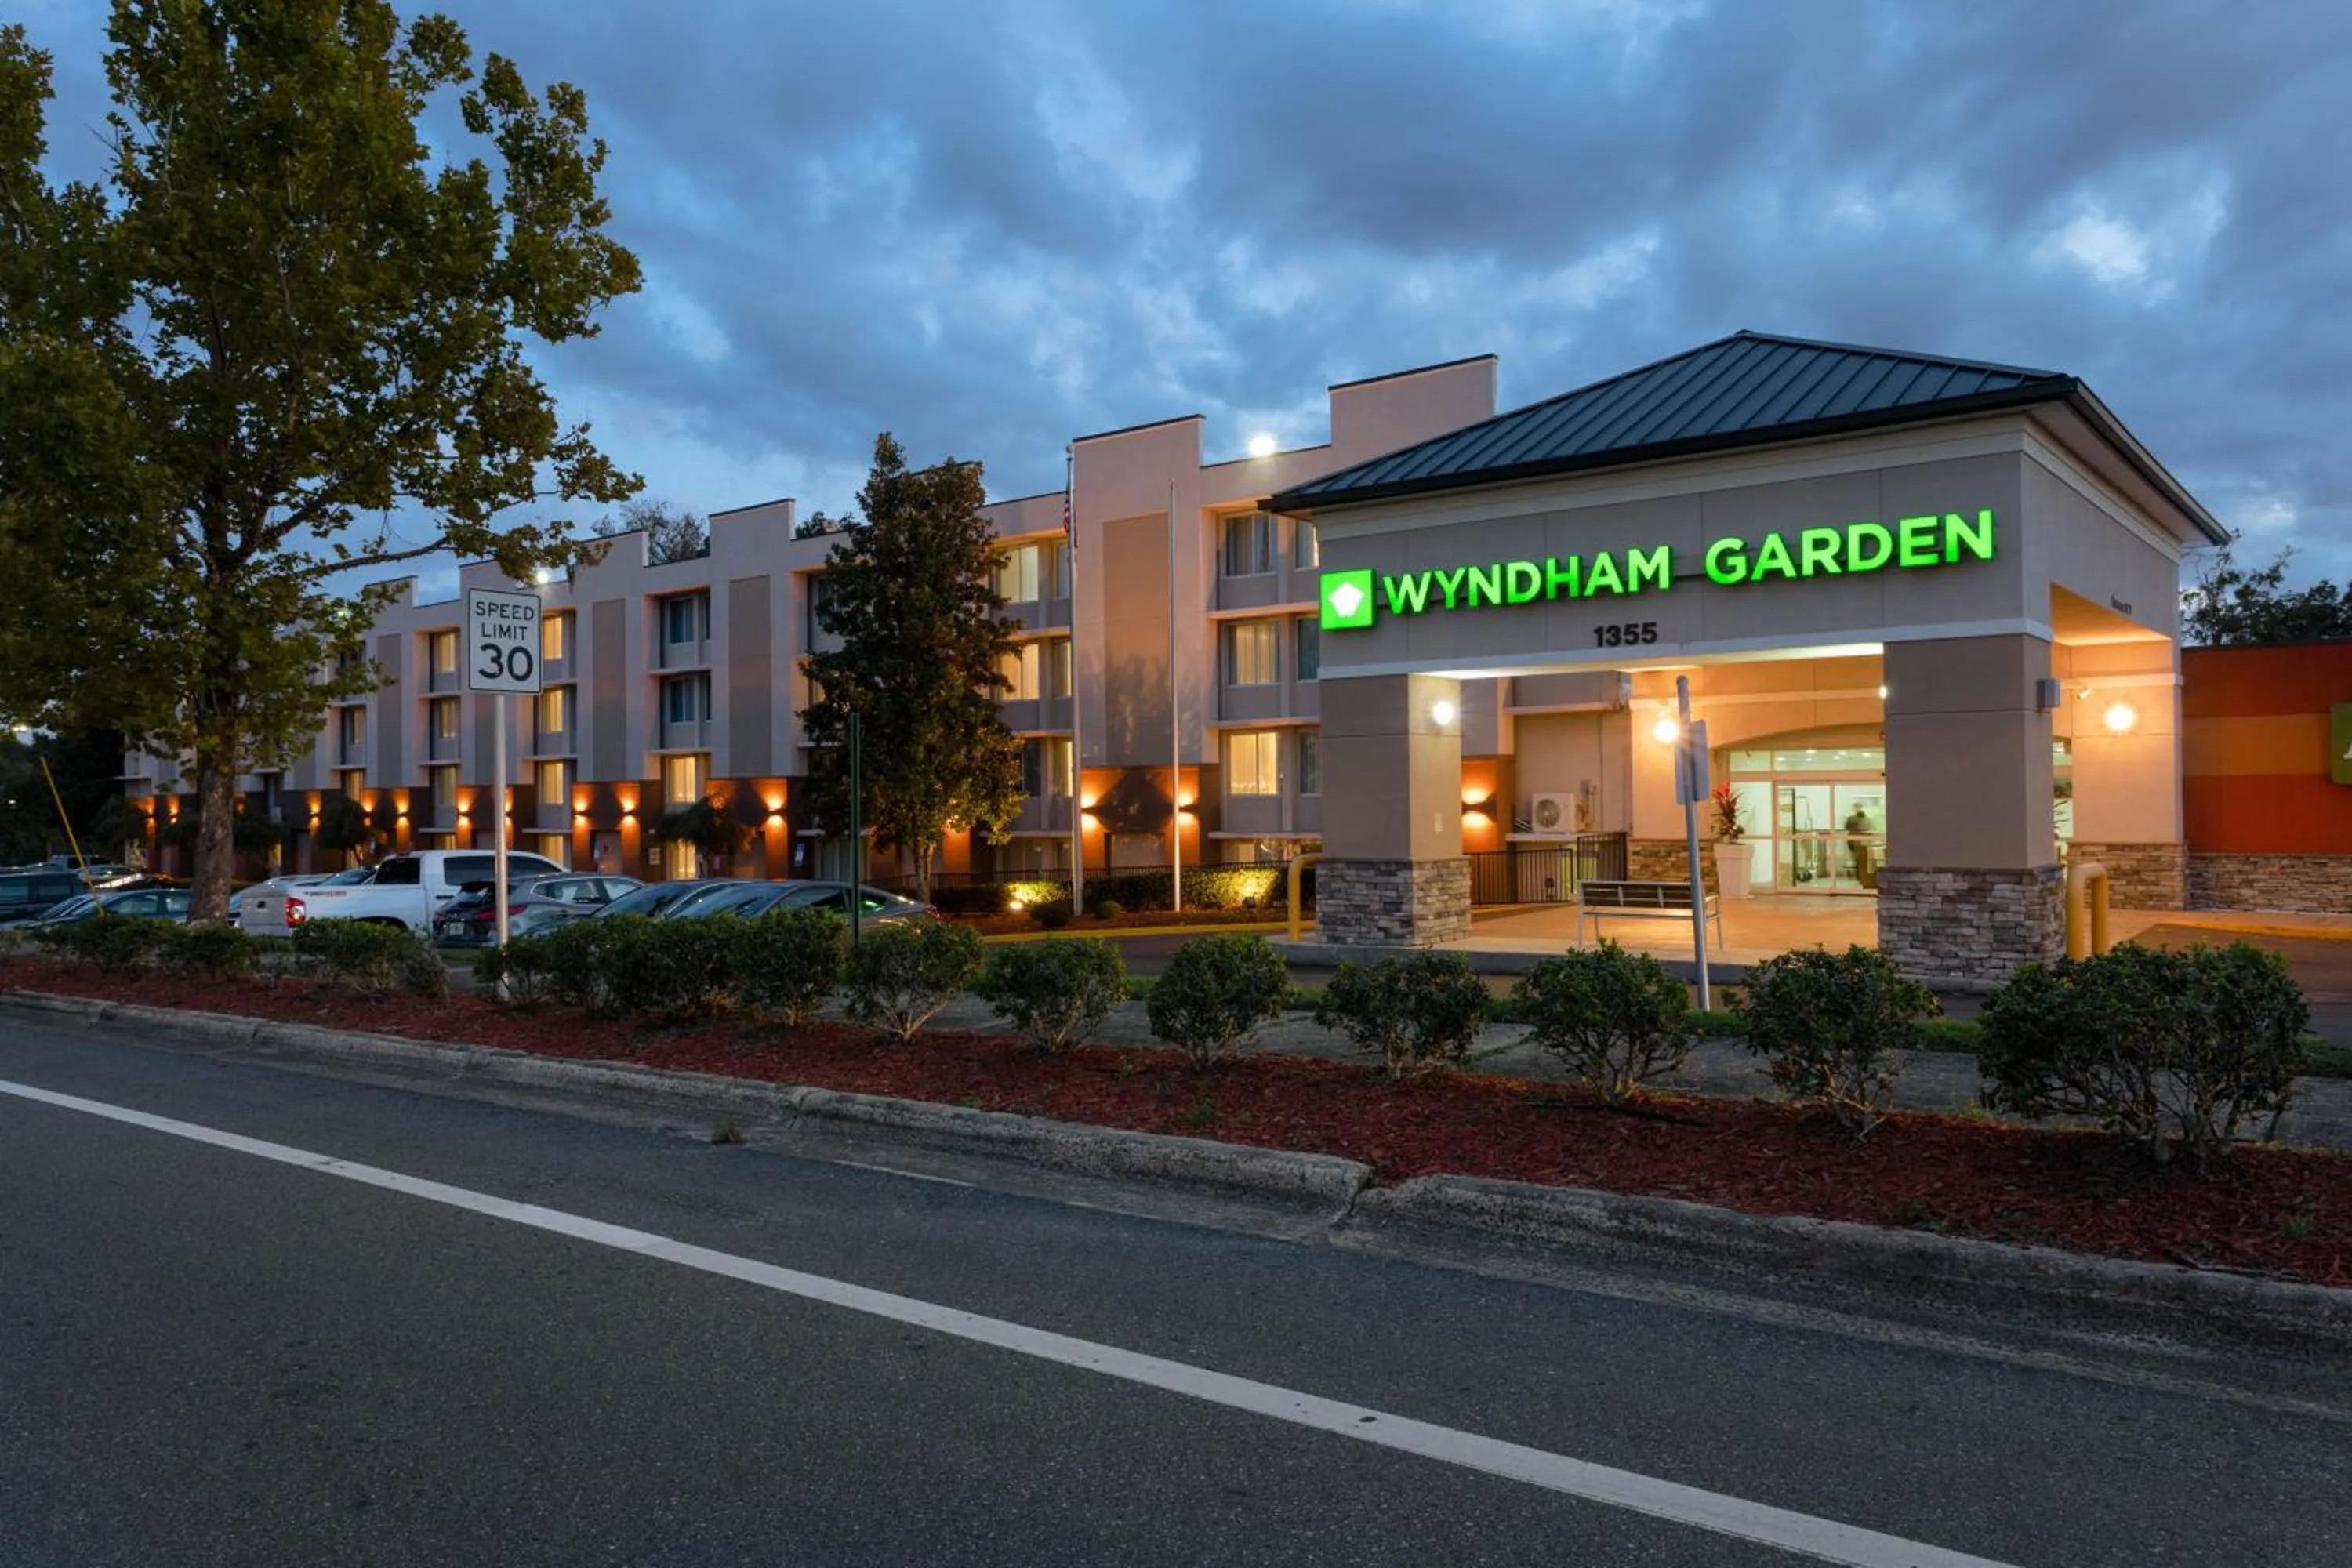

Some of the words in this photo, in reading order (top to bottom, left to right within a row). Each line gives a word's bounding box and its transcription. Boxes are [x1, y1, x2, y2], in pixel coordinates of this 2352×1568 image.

[1383, 544, 1673, 614] WYNDHAM
[1705, 508, 1994, 586] GARDEN
[476, 601, 534, 620] SPEED
[481, 622, 528, 641] LIMIT
[1593, 622, 1658, 648] 1355
[478, 642, 533, 681] 30
